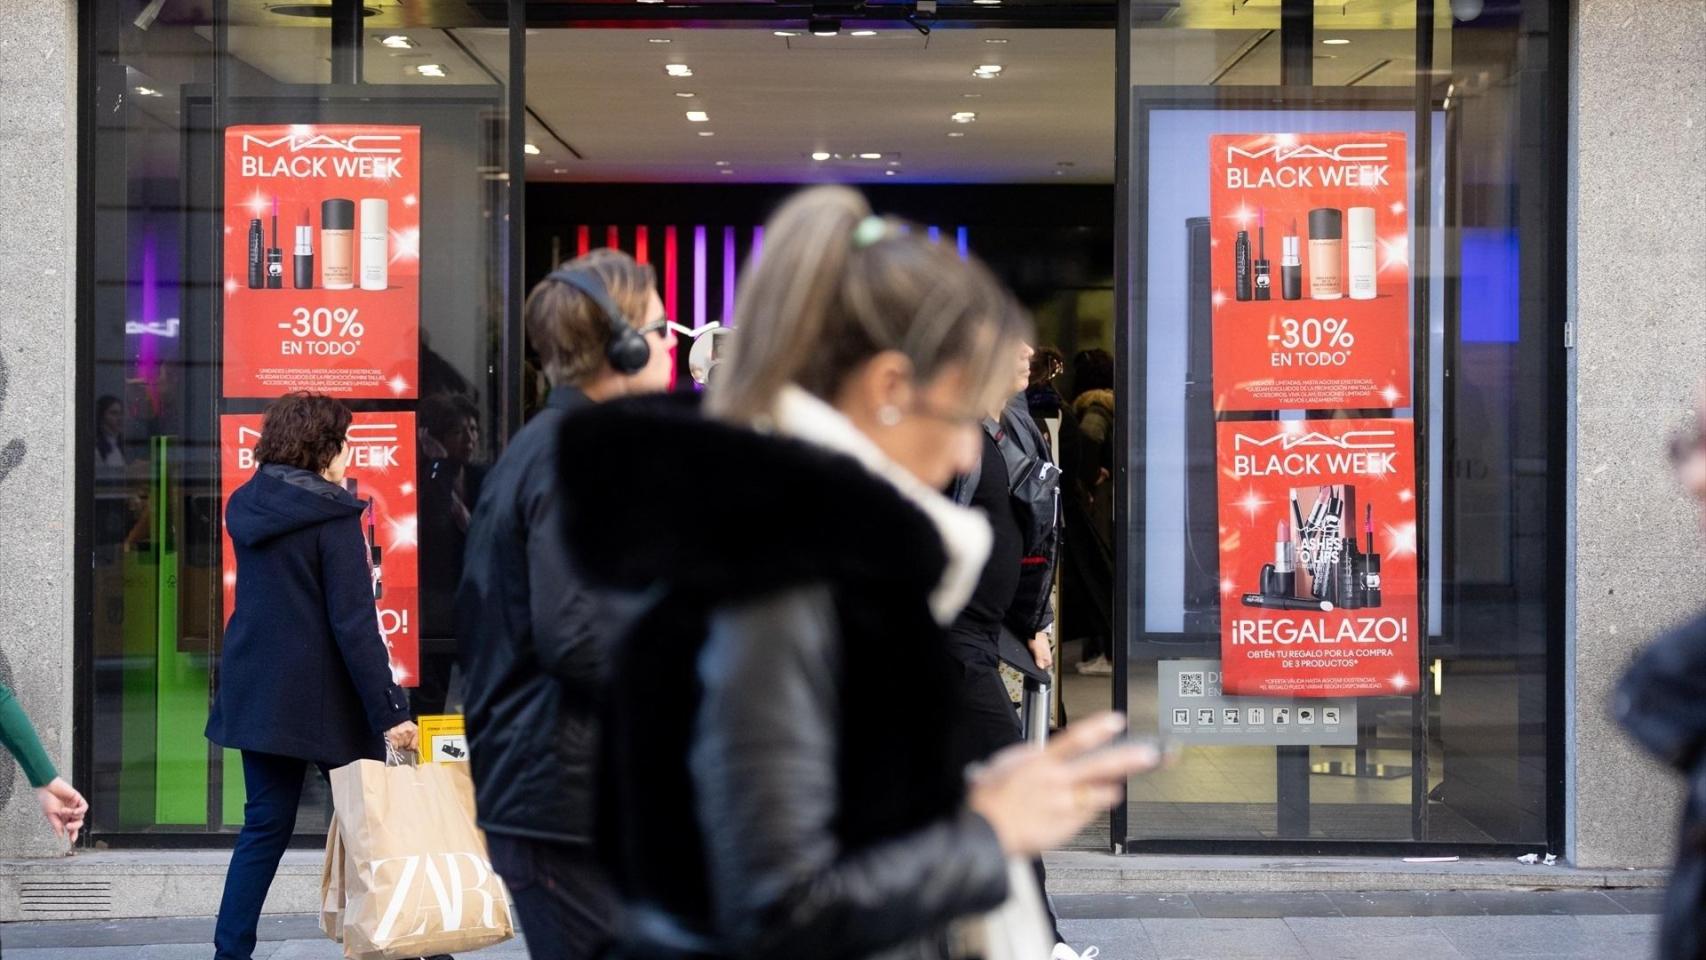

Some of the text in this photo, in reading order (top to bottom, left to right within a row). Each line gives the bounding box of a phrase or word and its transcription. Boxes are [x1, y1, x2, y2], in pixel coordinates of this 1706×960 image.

[242, 156, 403, 178] BLACK WEEK
[1227, 165, 1389, 188] BLACK WEEK
[278, 307, 364, 337] -30%
[1267, 318, 1355, 348] -30%
[282, 341, 302, 355] EN
[1271, 353, 1292, 366] EN
[1234, 452, 1397, 476] BLACK WEEK
[1232, 617, 1407, 645] ¡REGALAZO!
[1247, 648, 1275, 658] OBTÉN
[1277, 650, 1288, 658] TU
[1288, 650, 1323, 658] REGALO
[1343, 649, 1354, 657] LA
[1356, 649, 1394, 657] COMPRA
[1282, 660, 1293, 668] DE
[1294, 660, 1300, 668] 3
